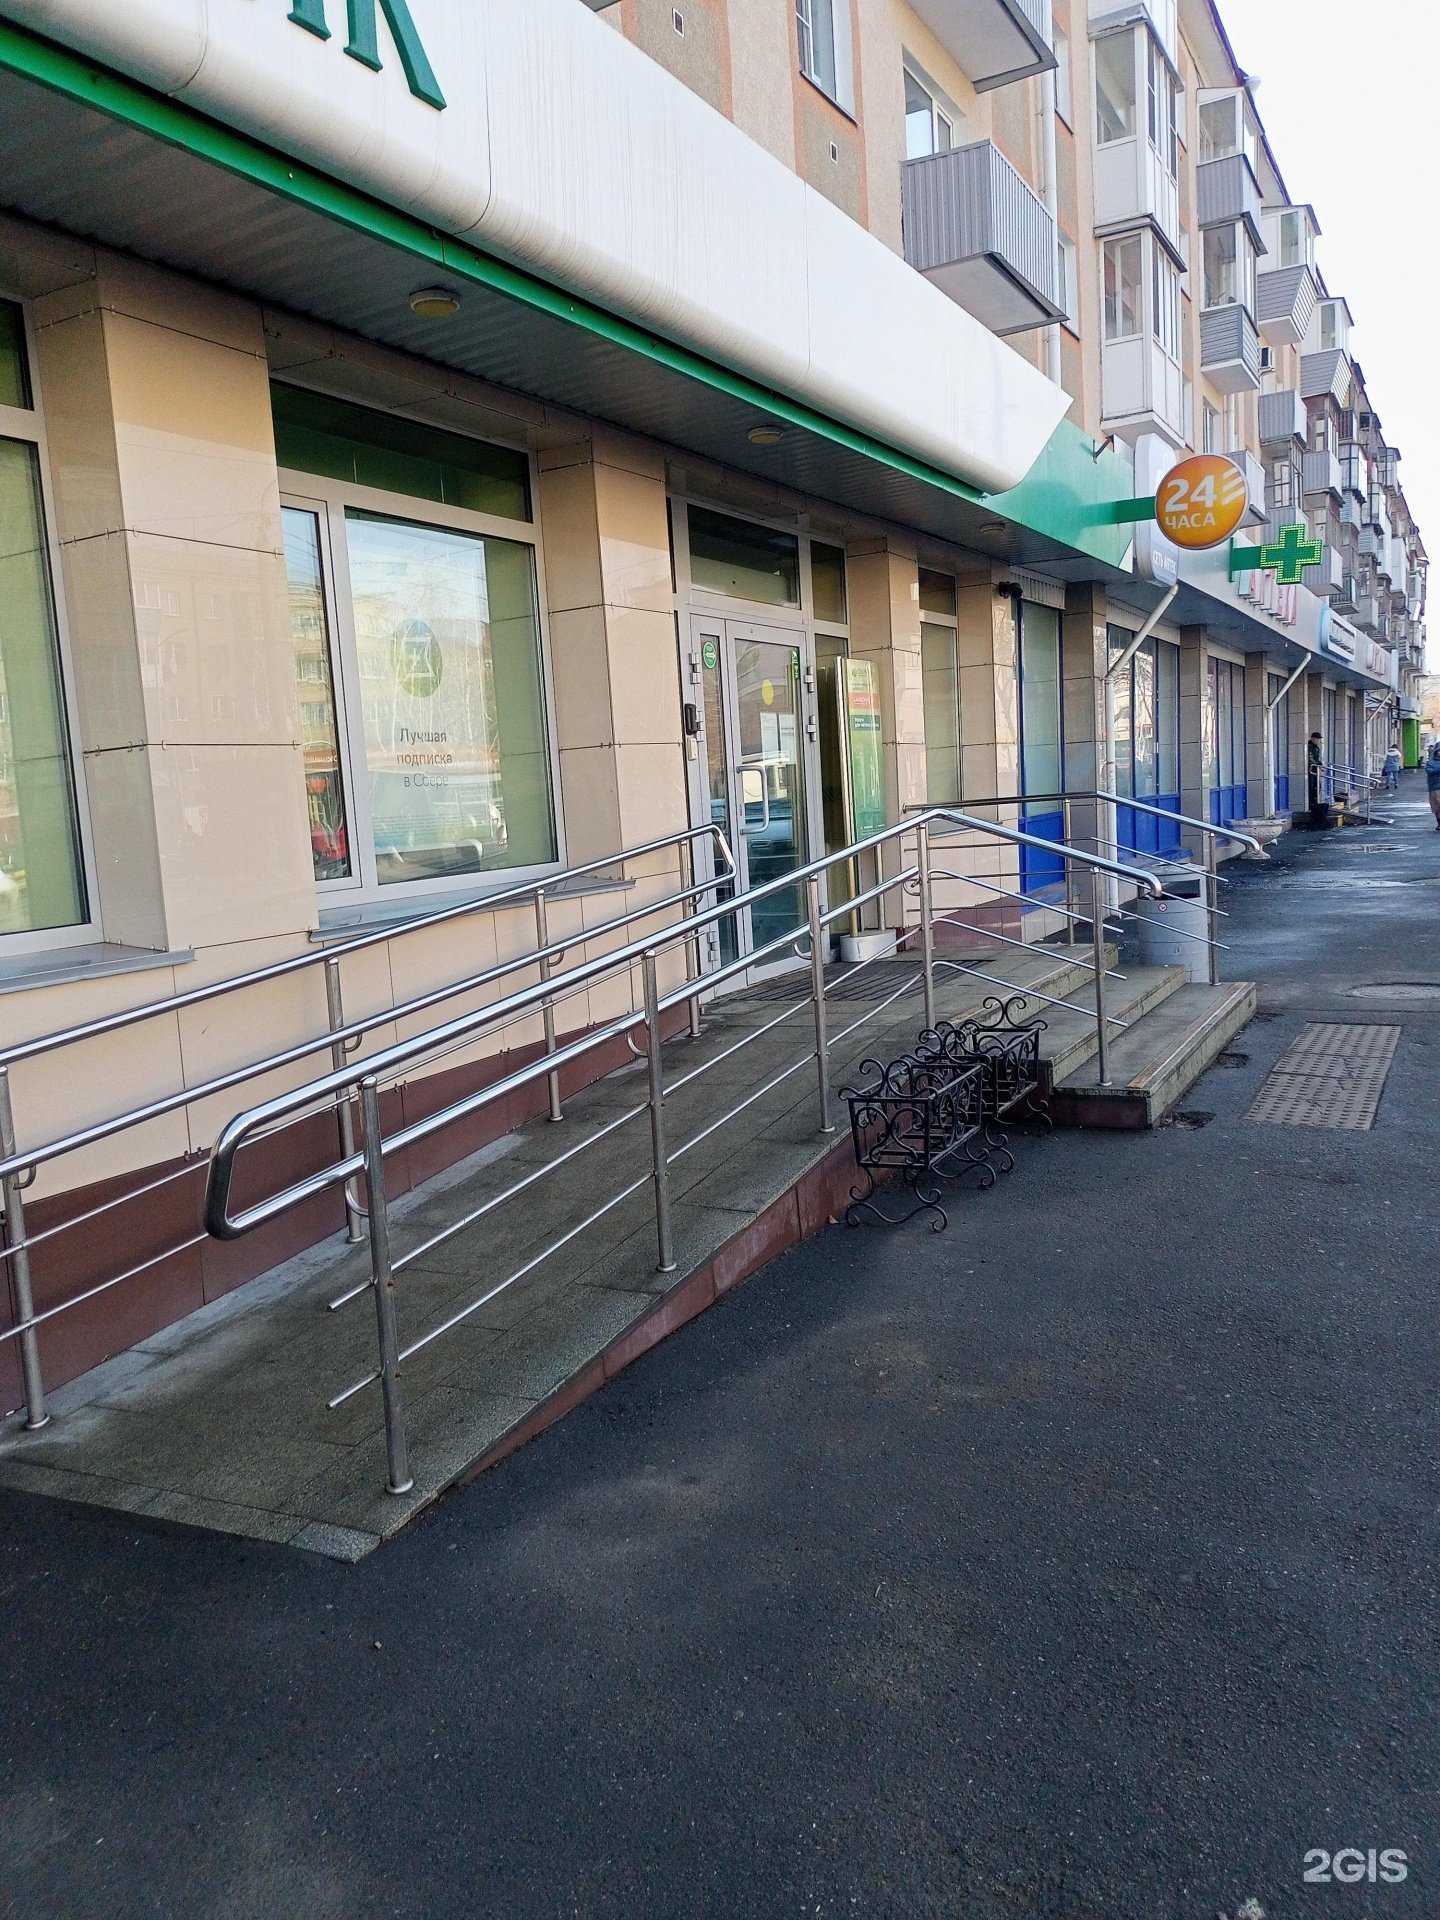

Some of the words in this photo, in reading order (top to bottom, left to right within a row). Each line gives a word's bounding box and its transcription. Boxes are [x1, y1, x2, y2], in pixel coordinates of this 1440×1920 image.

[1165, 474, 1217, 513] 24
[1165, 512, 1216, 529] ЧАСА
[400, 728, 447, 745] Лучшая
[396, 753, 453, 767] подписка
[403, 776, 411, 787] в
